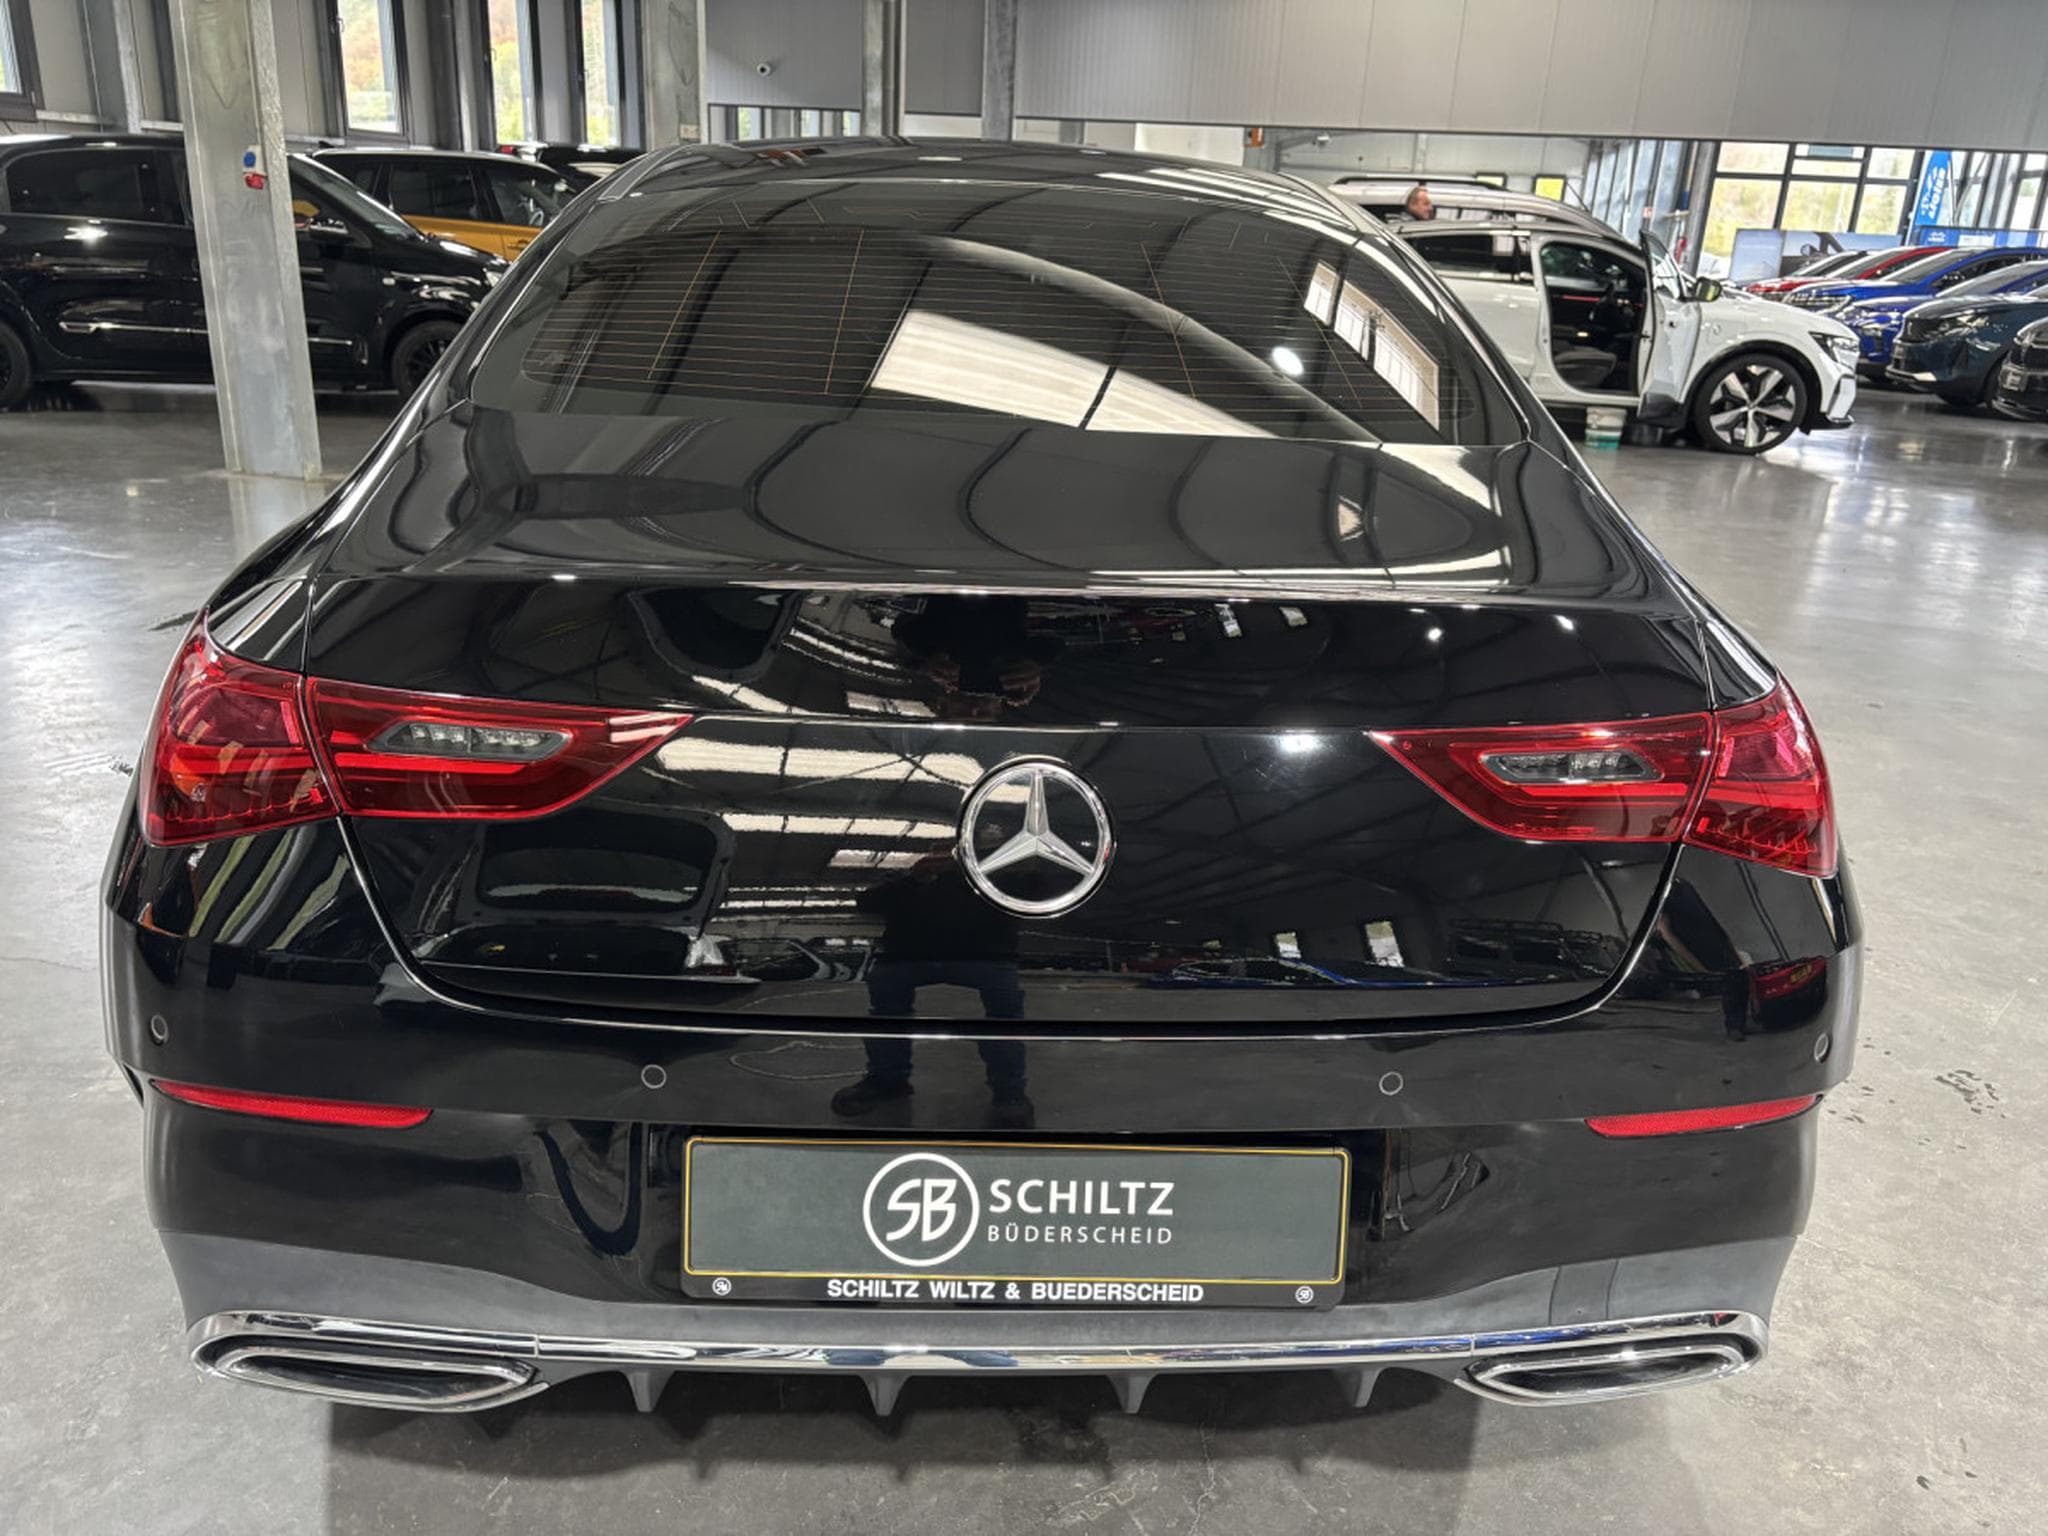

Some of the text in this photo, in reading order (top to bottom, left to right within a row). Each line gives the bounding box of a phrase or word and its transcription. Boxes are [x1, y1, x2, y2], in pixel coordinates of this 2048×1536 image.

[988, 1178, 1175, 1216] SCHILTZ
[987, 1222, 1172, 1245] BÜDERSCHEID
[827, 1279, 1204, 1303] SCHILTZ WILTZ & BUEDERSCHEID
